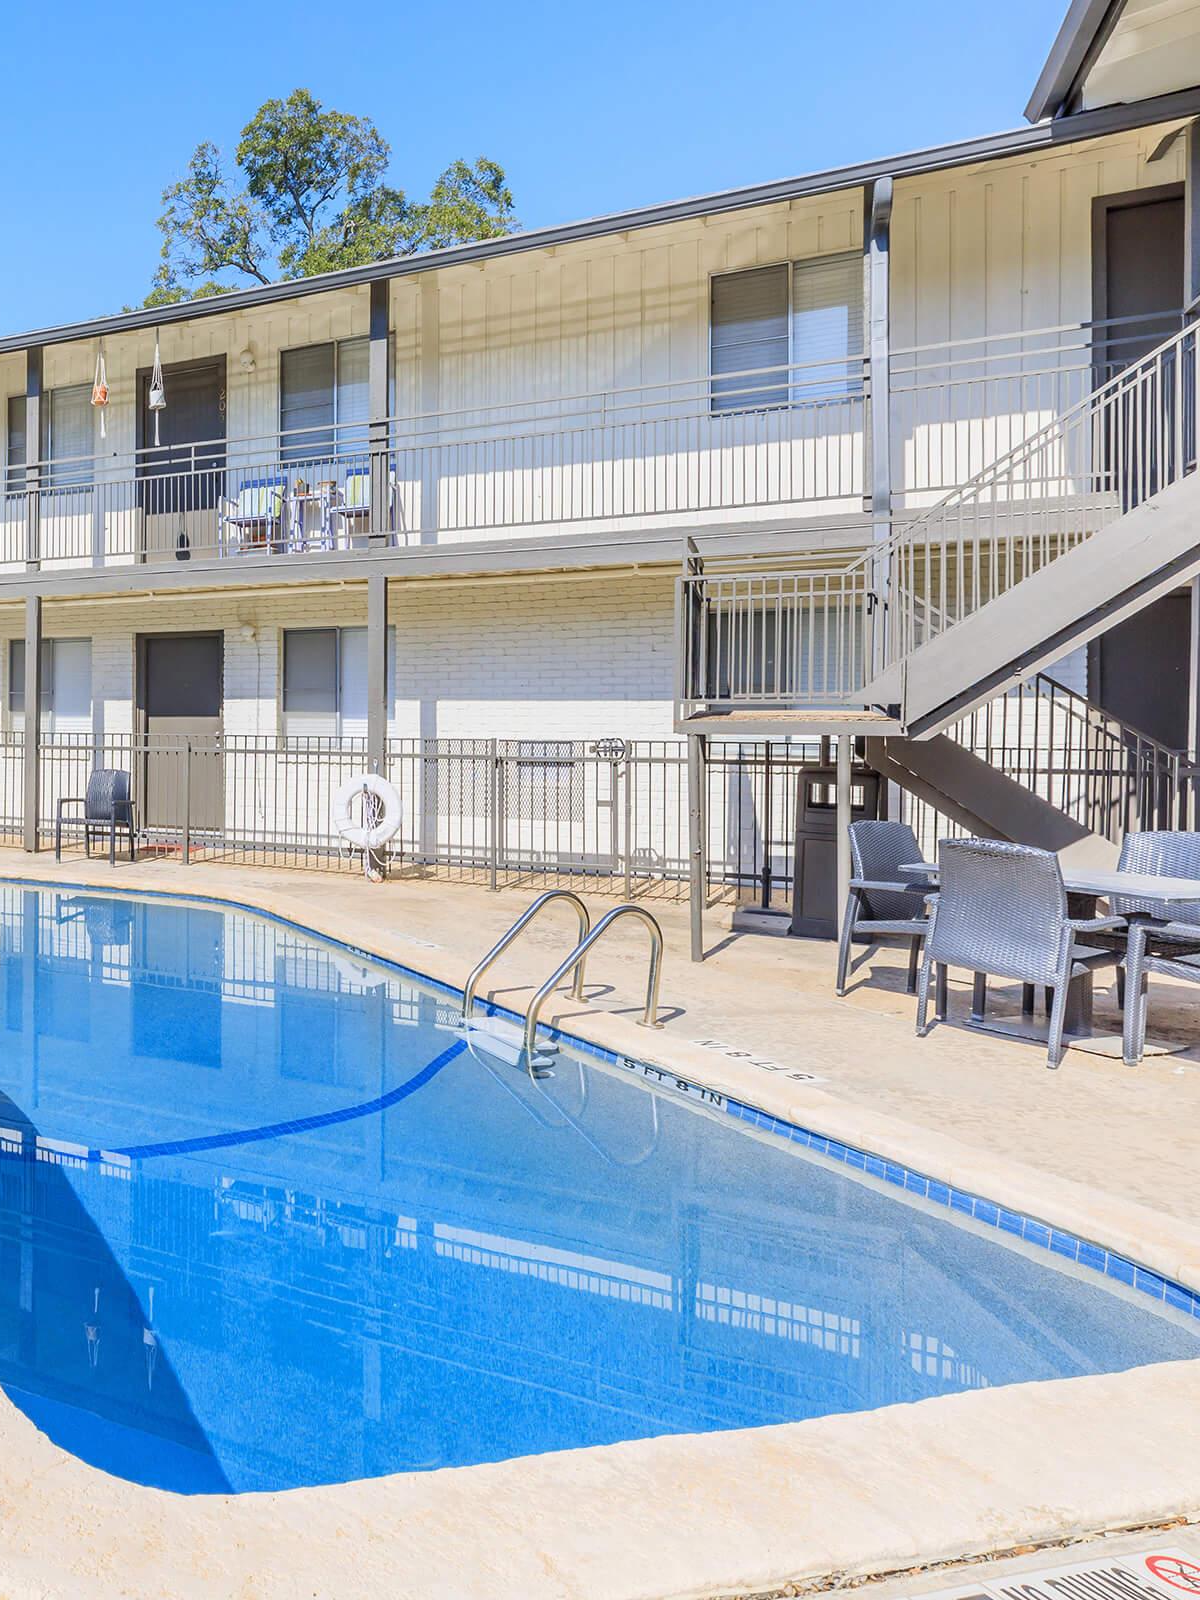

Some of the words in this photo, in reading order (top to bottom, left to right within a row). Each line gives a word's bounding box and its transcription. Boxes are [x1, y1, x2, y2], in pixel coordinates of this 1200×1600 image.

[693, 1040, 729, 1049] IN
[748, 1061, 790, 1072] FT
[623, 1057, 636, 1069] 5
[644, 1066, 667, 1081] FT
[675, 1080, 689, 1091] 8
[701, 1089, 722, 1106] IN
[785, 1073, 815, 1081] 5
